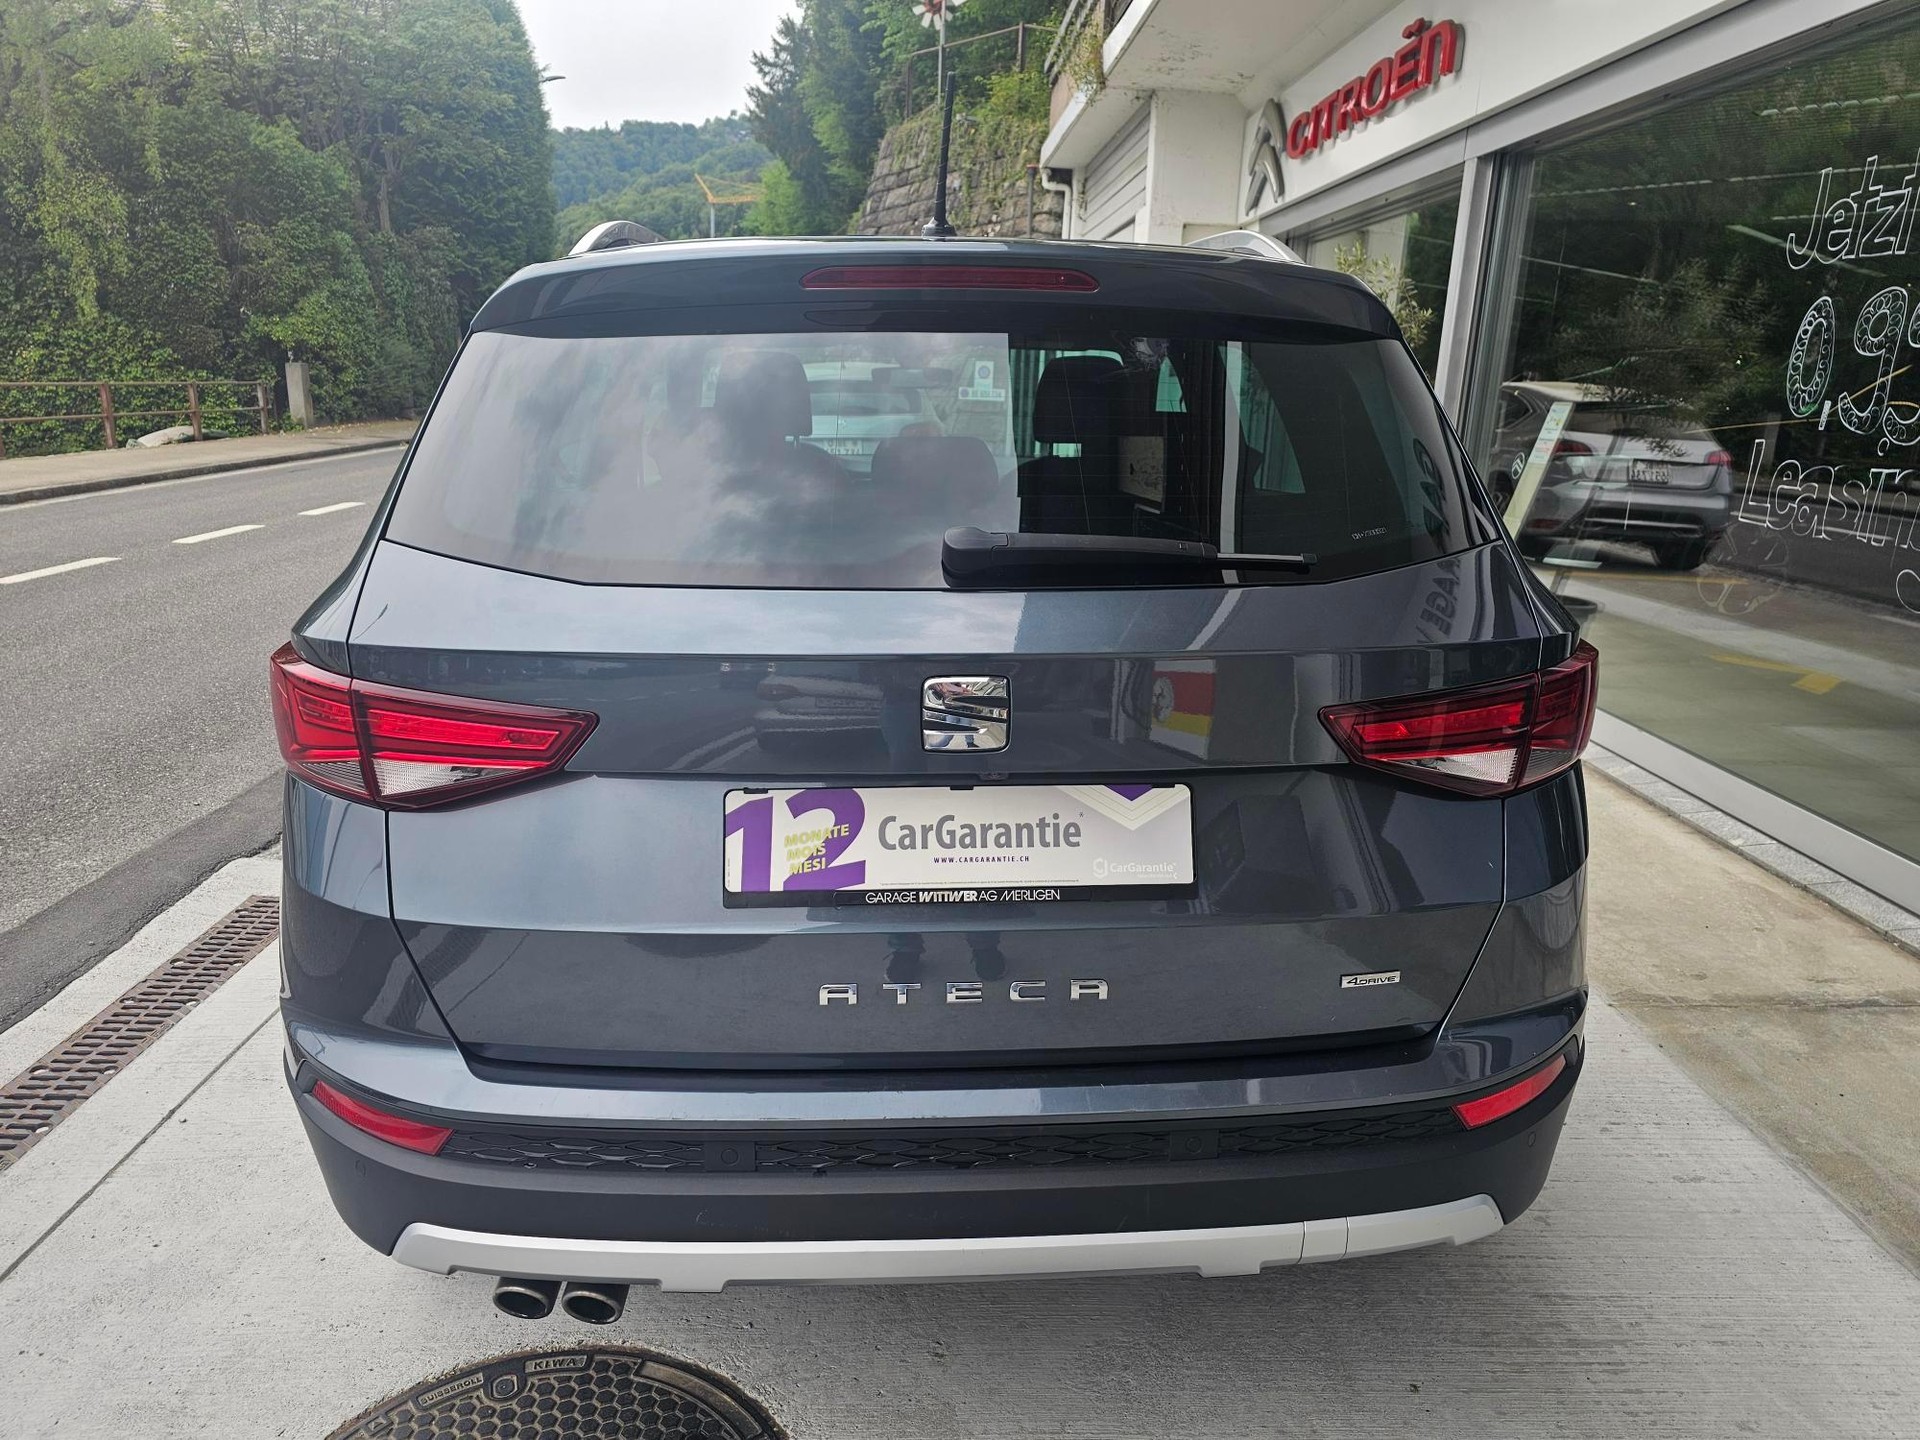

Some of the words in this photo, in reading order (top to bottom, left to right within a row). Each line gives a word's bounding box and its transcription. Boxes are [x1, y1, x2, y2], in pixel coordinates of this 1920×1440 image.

[1286, 17, 1460, 160] CITROËN
[725, 788, 867, 893] 12
[784, 823, 850, 847] MONATE
[878, 813, 1082, 850] CarGarantie
[786, 843, 826, 862] MOIS
[933, 855, 1030, 864] WWW.CARGARANTIE.CH
[788, 857, 826, 875] MESI
[1109, 862, 1174, 874] CarGarantie
[865, 891, 917, 904] GARAGE
[918, 890, 978, 903] WITTWER
[979, 889, 998, 902] AG
[999, 888, 1061, 902] MERLIGEN
[1346, 975, 1397, 986] 4DRIVE
[819, 978, 1109, 1006] ATECA
[532, 1358, 577, 1371] KIWA
